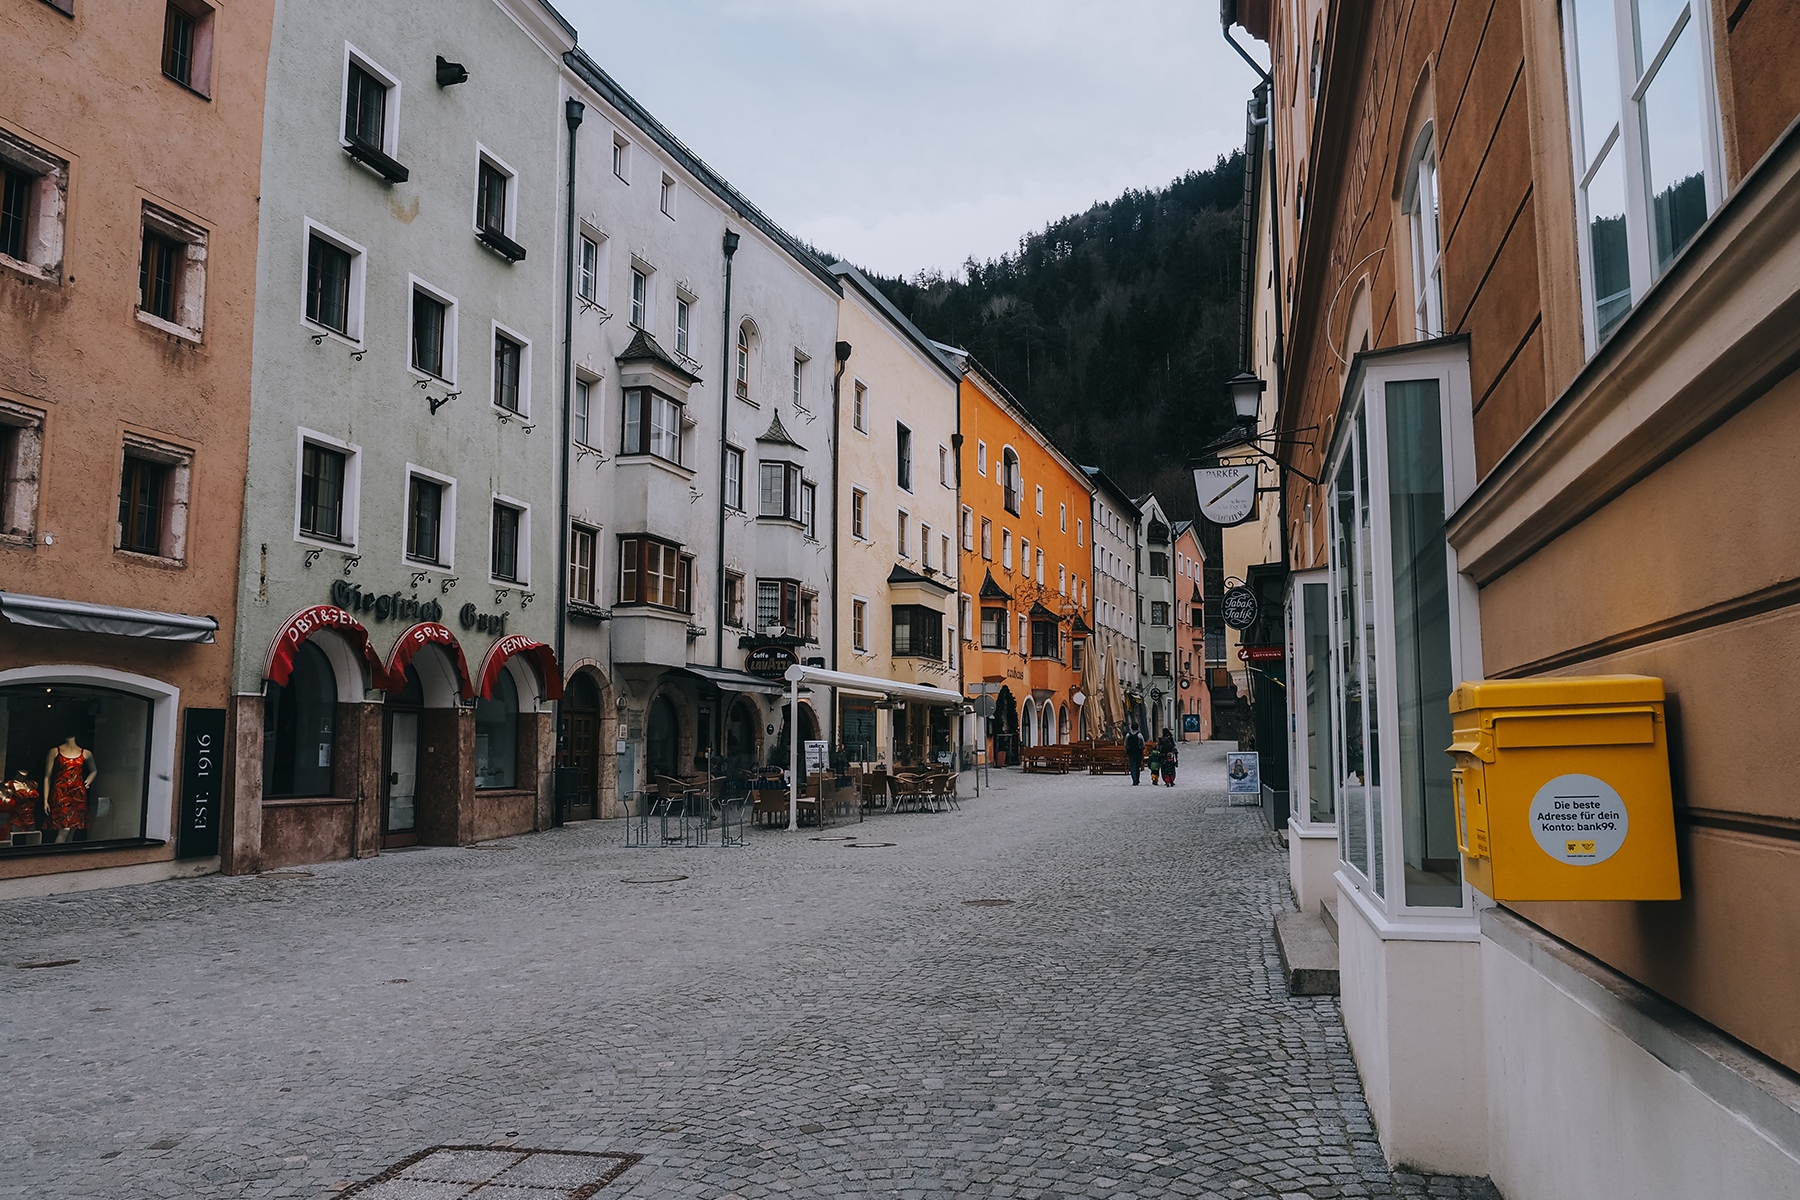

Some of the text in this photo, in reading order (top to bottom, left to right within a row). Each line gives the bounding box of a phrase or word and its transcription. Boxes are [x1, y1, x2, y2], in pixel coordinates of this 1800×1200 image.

[1225, 596, 1254, 610] Tabak
[1225, 608, 1254, 621] Trafik
[194, 734, 213, 829] EST. 1916
[1554, 801, 1601, 810] Die beste
[1537, 811, 1620, 821] Adresse für dein
[1542, 822, 1617, 832] Konto: bank99.
